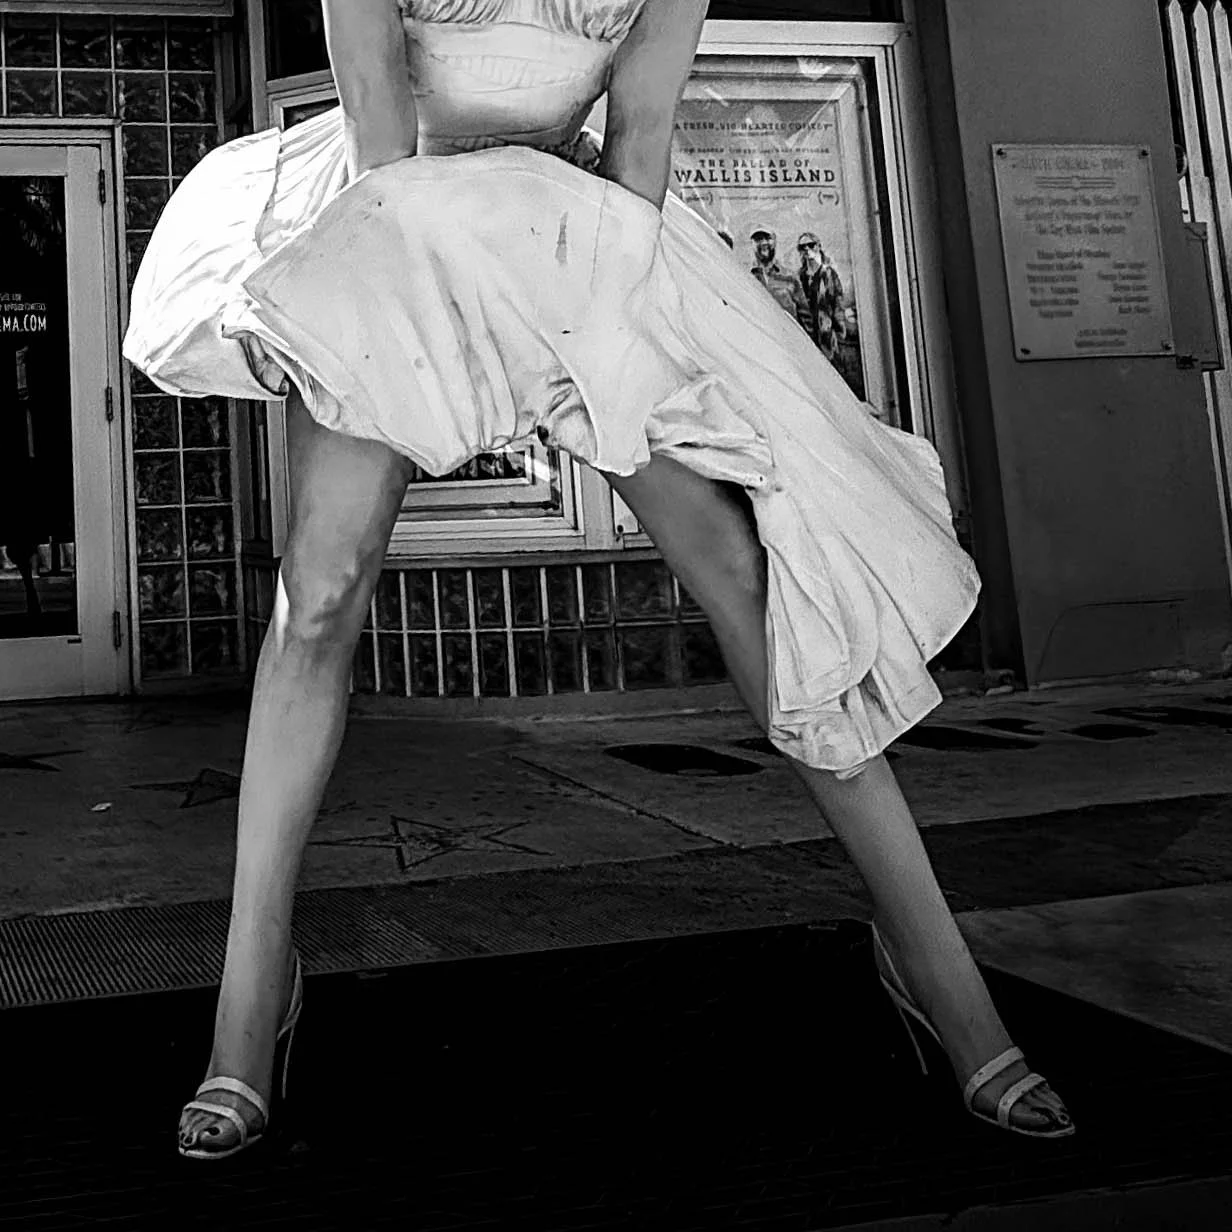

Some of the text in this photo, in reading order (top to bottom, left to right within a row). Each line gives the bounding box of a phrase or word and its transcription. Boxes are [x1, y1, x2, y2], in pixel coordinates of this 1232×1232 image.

[699, 159, 810, 168] THE BALLAD OF
[674, 169, 836, 183] WALLIS ISLAND
